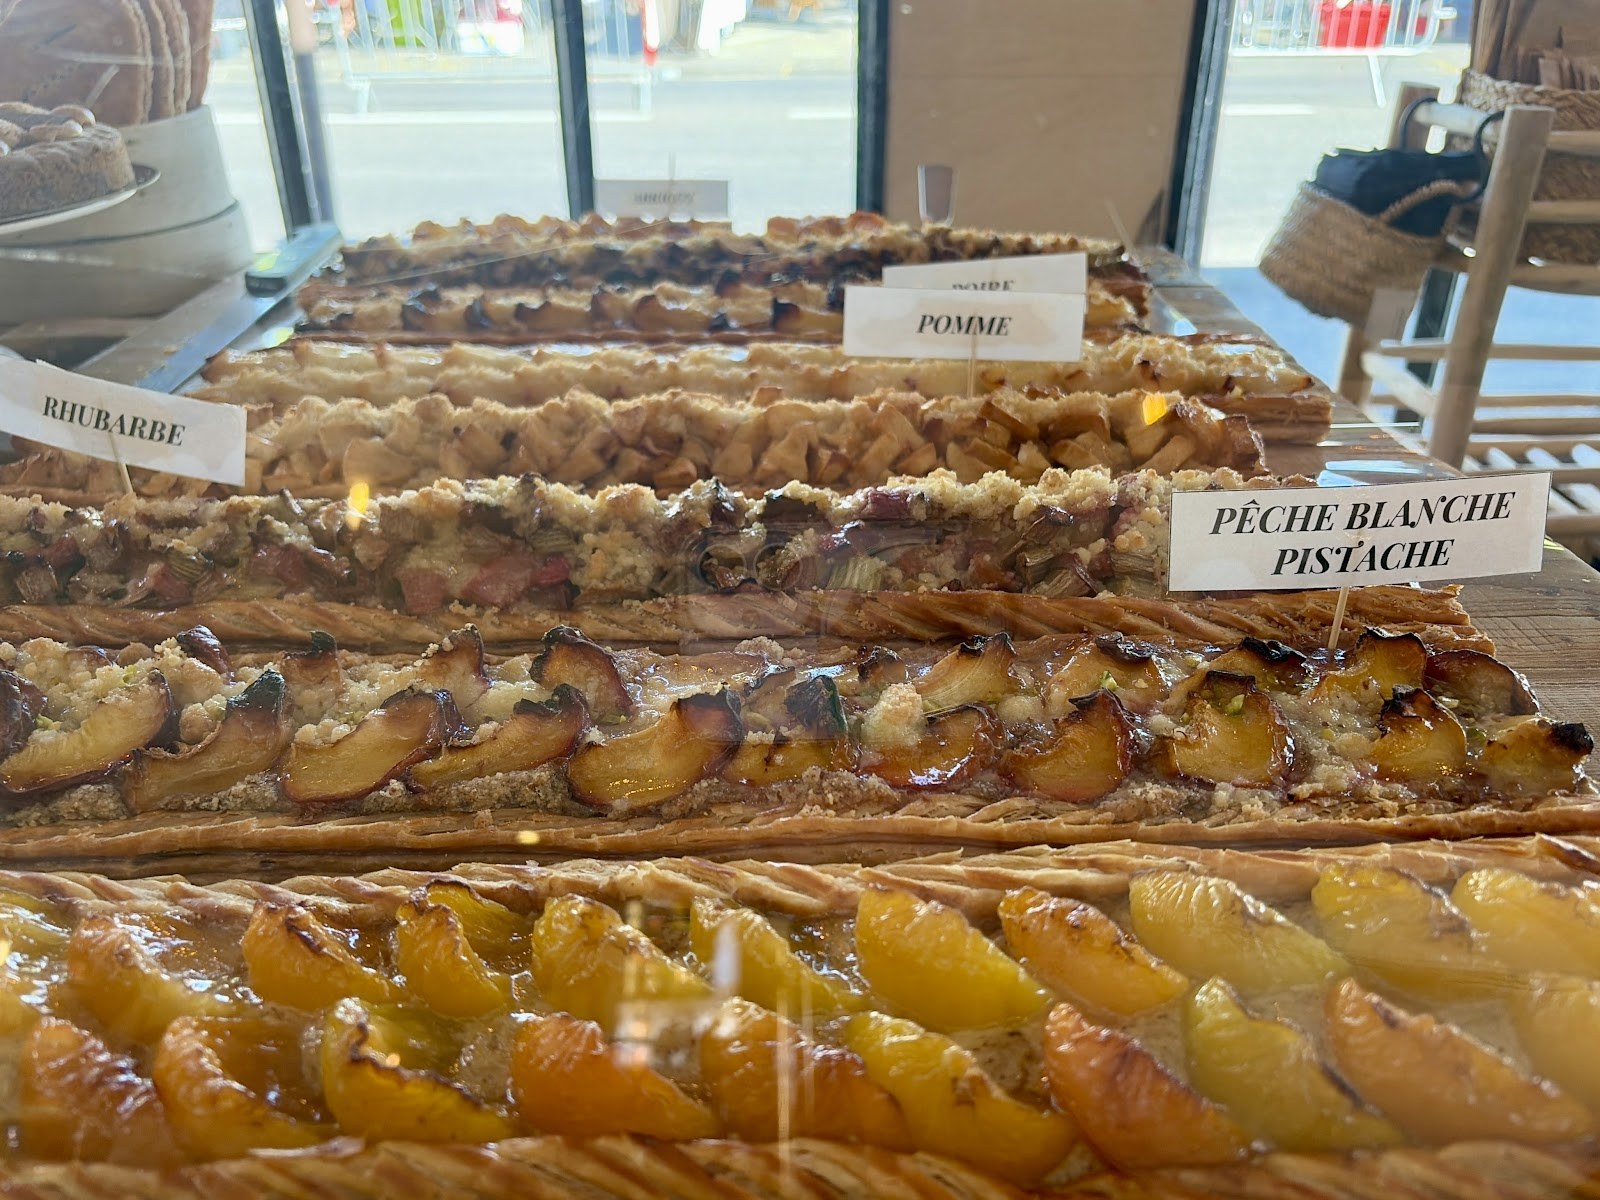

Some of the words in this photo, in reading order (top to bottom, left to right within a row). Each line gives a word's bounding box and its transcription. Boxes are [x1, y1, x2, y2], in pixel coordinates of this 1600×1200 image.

[917, 314, 1012, 336] POMME
[43, 395, 186, 446] RHUBARBE
[1209, 499, 1339, 534] PÊCHE
[1343, 492, 1516, 530] BLANCHE
[1270, 539, 1455, 575] PISTACHE
